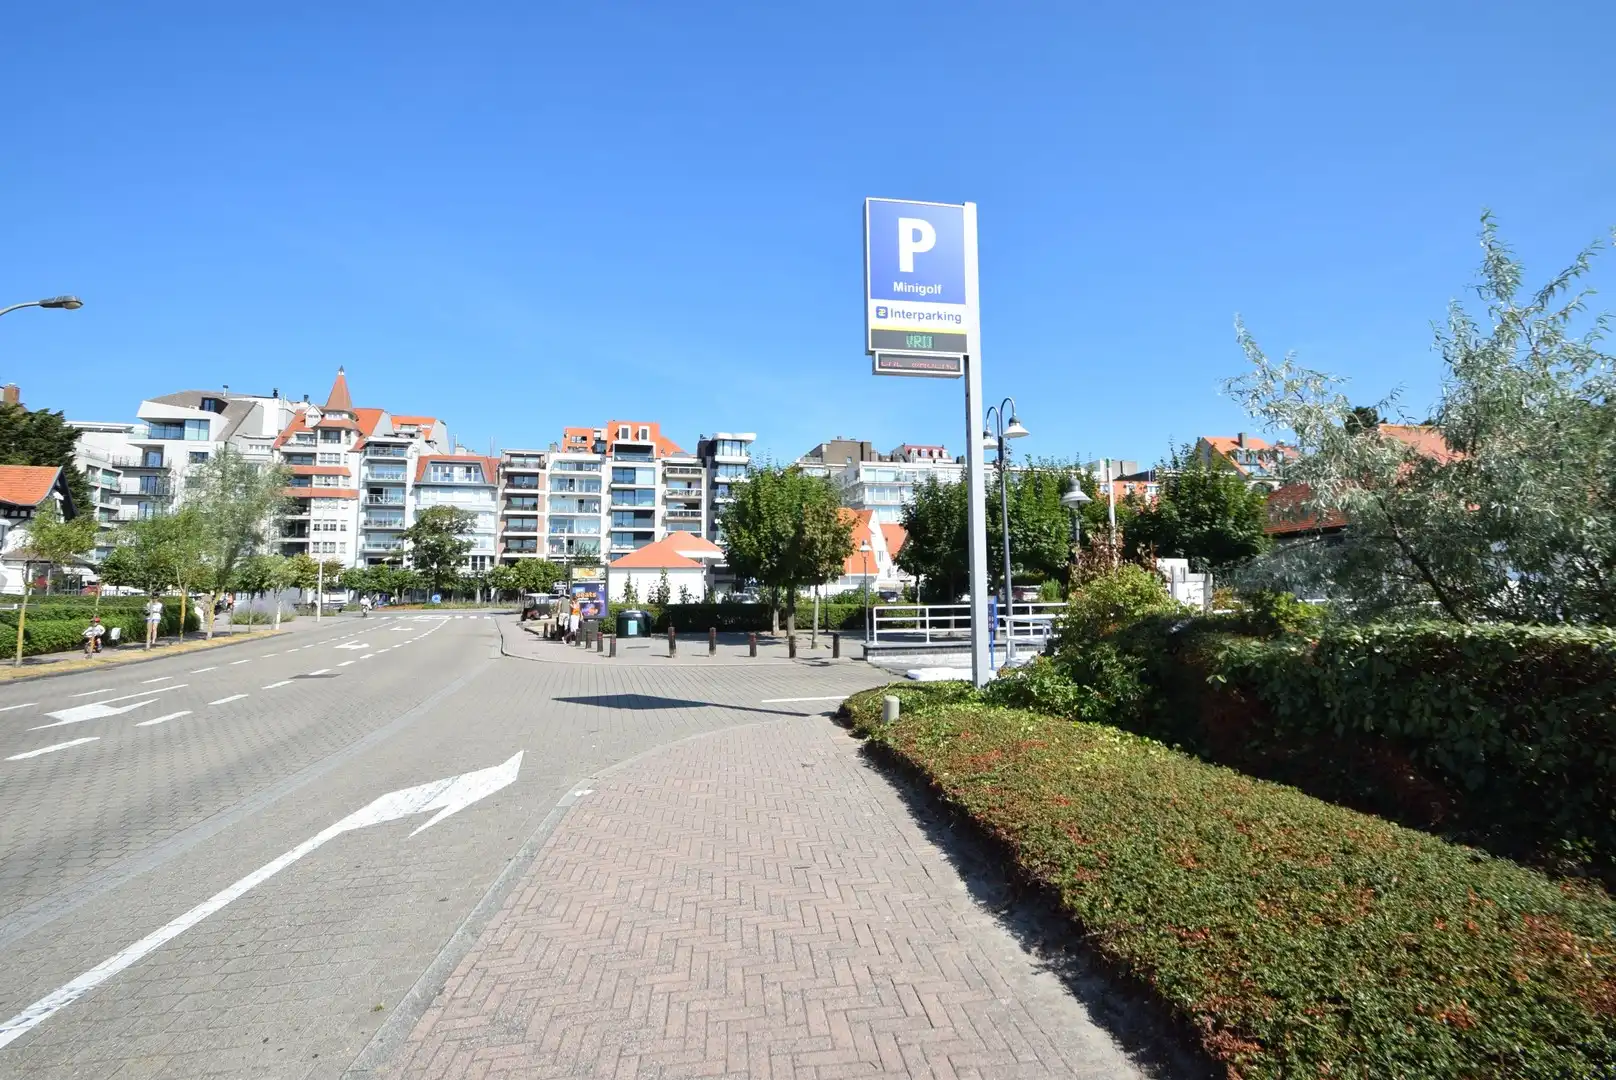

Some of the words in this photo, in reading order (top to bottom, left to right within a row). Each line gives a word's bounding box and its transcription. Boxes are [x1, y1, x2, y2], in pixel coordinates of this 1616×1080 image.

[898, 217, 936, 273] P
[893, 281, 942, 296] Minigolf
[890, 308, 962, 324] Interparking
